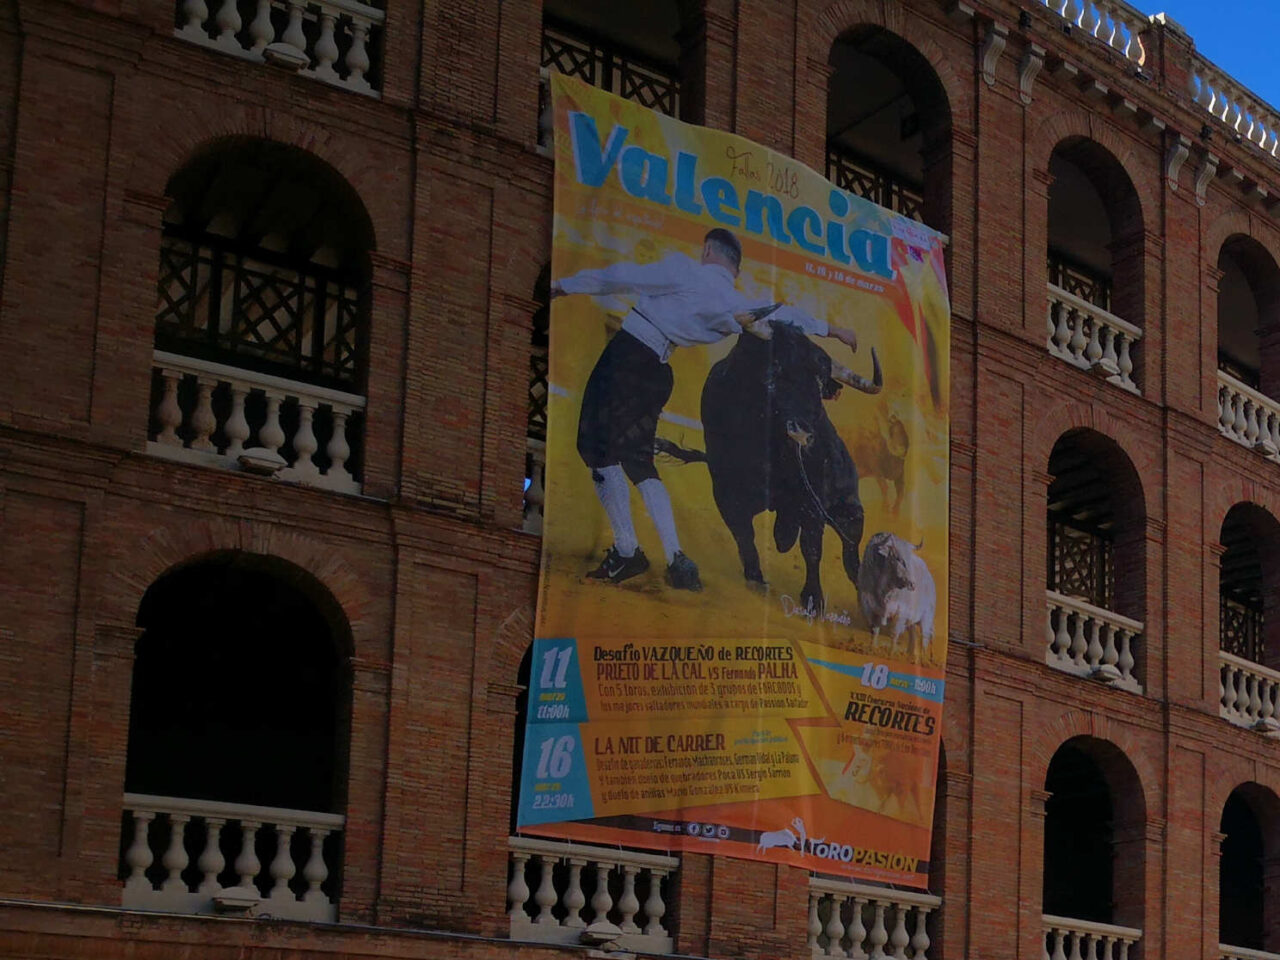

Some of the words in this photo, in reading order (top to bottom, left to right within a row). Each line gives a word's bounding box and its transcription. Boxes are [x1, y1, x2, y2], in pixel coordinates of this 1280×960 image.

[568, 110, 897, 280] Valencia
[766, 161, 800, 200] 2018
[540, 646, 573, 689] 11
[594, 643, 640, 661] Desafío
[642, 645, 714, 663] VAZQUEÑO
[718, 646, 732, 661] de
[736, 646, 793, 661] RECORTES
[597, 662, 640, 681] PRIETO
[643, 663, 660, 681] DE
[662, 662, 680, 680] LA
[682, 662, 706, 680] CAL
[758, 662, 798, 680] PALHA
[861, 662, 889, 690] 18
[537, 704, 570, 719] 11:00h
[845, 701, 936, 736] RECORTES
[536, 735, 575, 779] 16
[595, 736, 614, 755] LA
[619, 736, 642, 754] NIT
[645, 735, 664, 753] DE
[667, 733, 726, 753] CARRER
